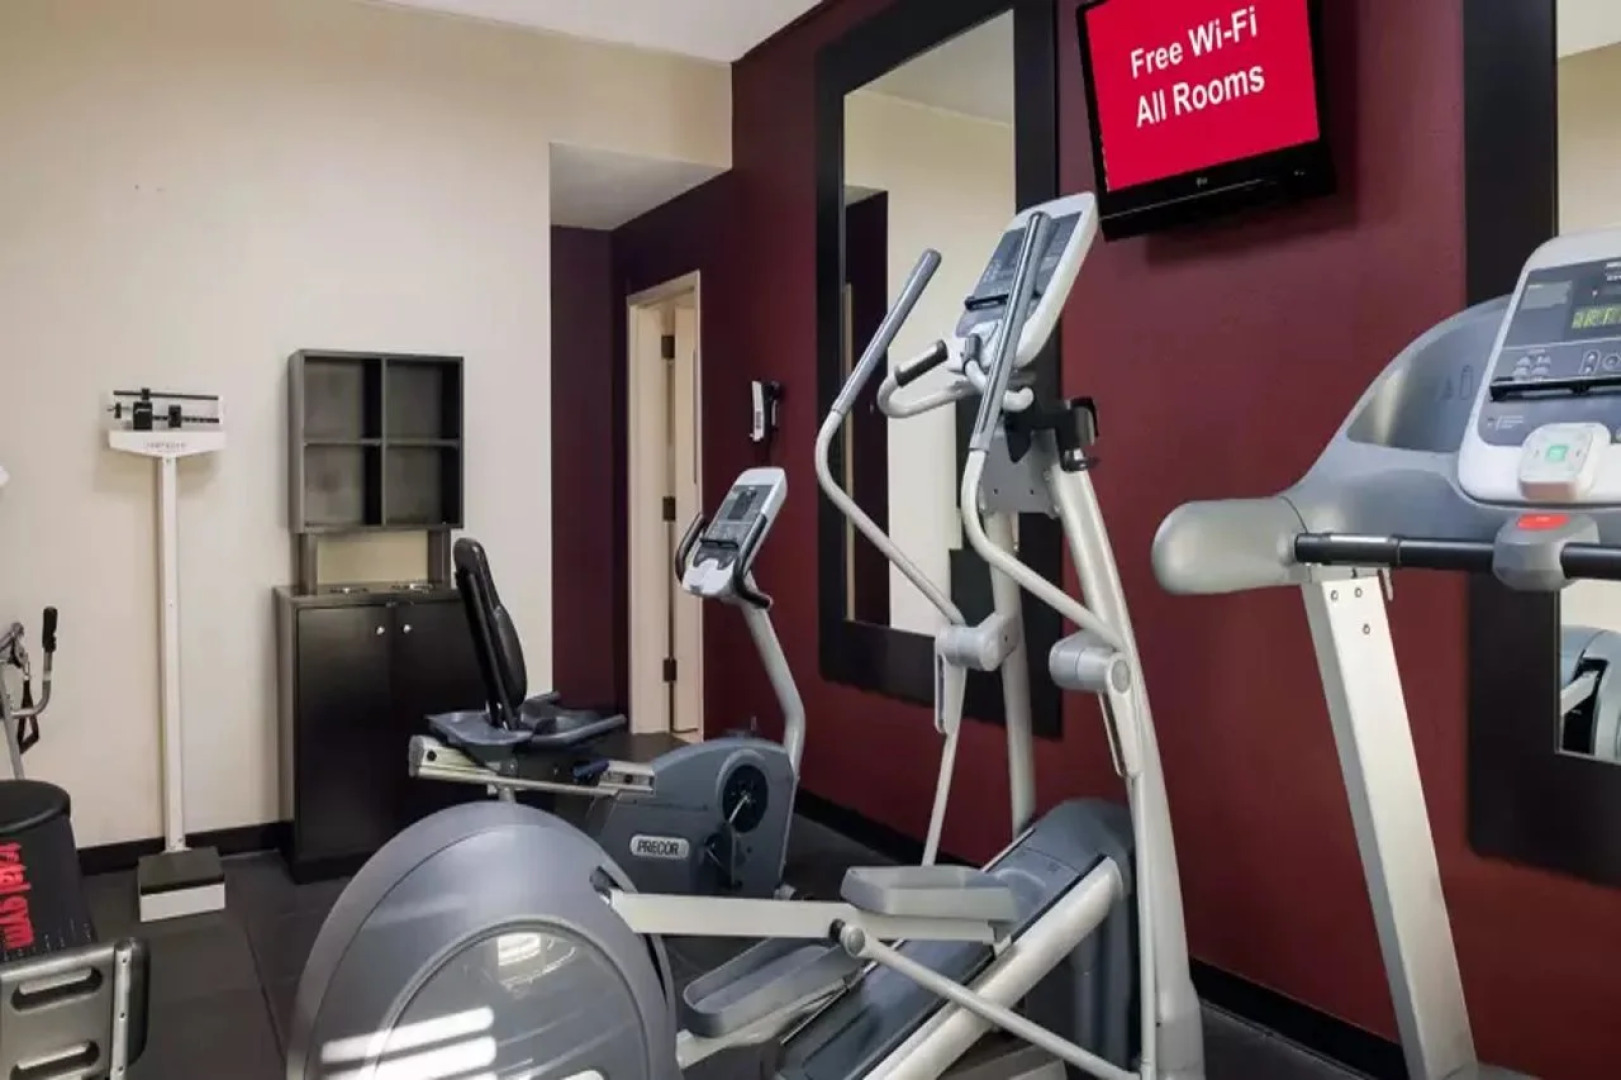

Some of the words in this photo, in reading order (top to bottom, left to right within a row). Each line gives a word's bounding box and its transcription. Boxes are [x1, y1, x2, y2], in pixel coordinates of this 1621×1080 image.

[1130, 42, 1183, 79] Free
[1188, 6, 1257, 57] Wi-Fi
[1136, 89, 1167, 128] All
[1172, 65, 1265, 116] Rooms
[637, 840, 680, 855] PRECOR
